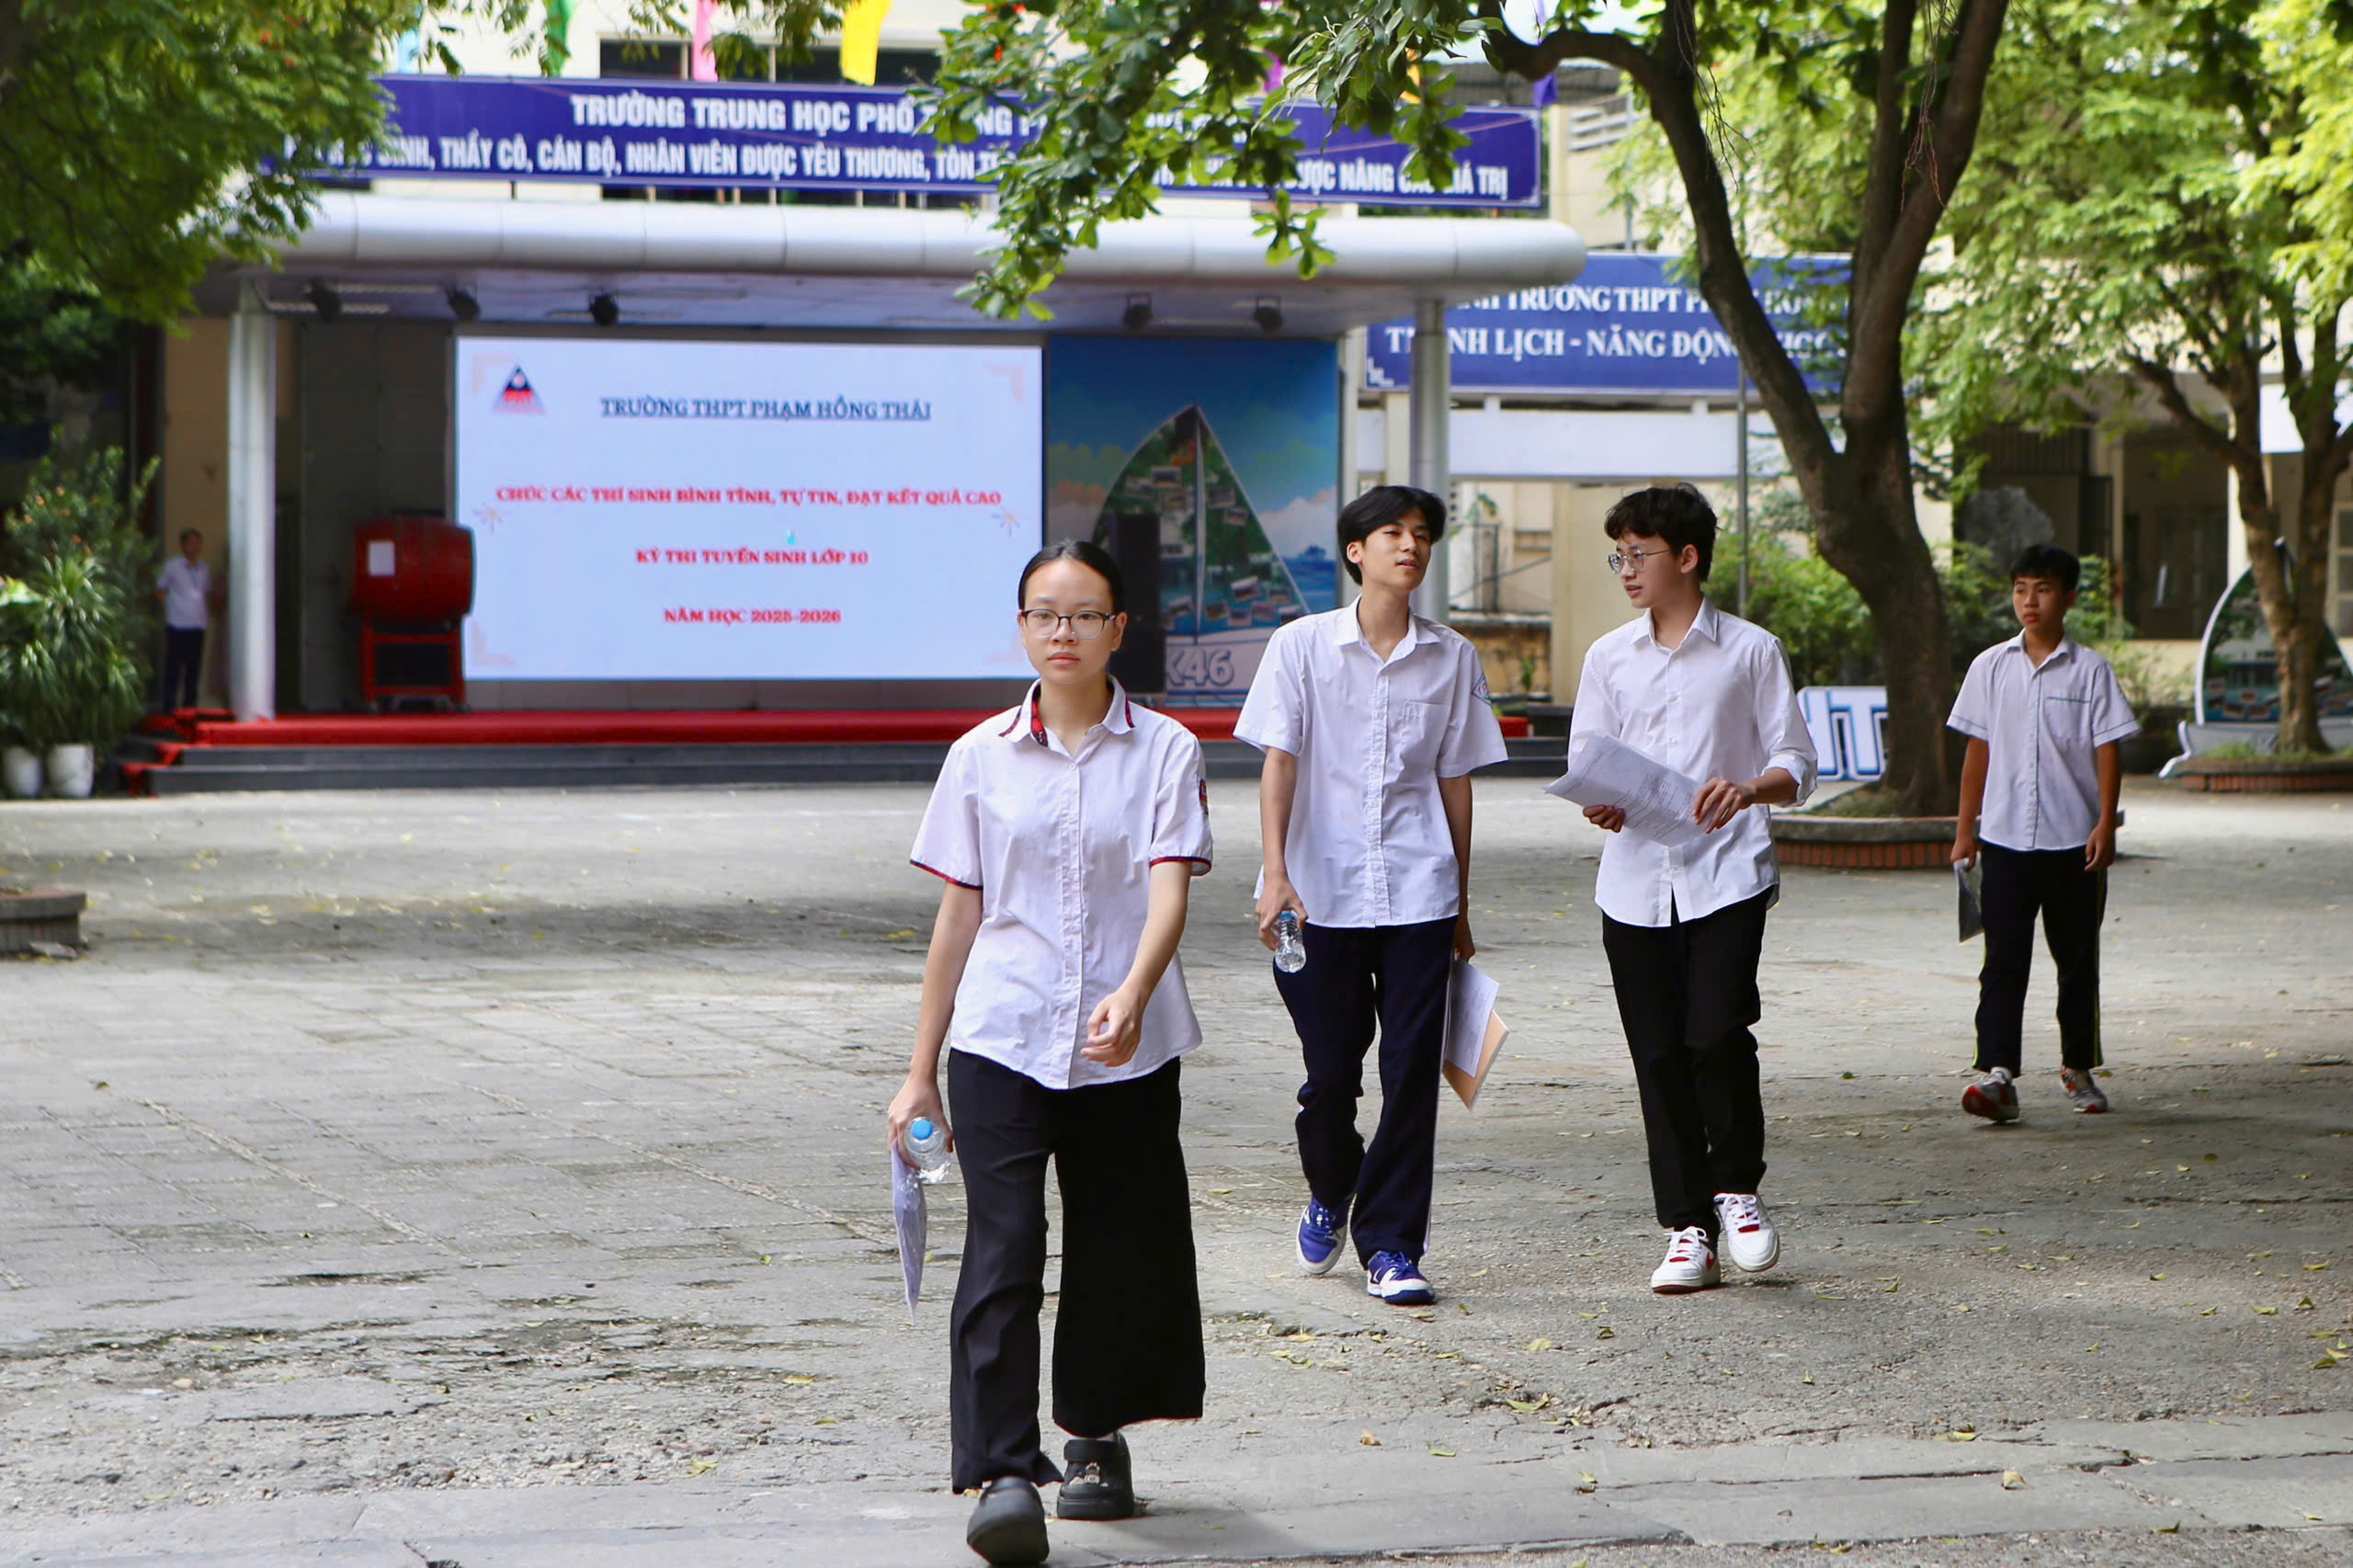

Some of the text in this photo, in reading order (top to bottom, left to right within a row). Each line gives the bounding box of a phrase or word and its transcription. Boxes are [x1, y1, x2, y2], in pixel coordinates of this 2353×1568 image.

[571, 89, 686, 128] TRƯỜNG
[692, 97, 787, 131] TRUNG
[792, 100, 850, 137] HỌC
[498, 132, 533, 173] CÔ,
[538, 133, 582, 171] CÁN
[586, 136, 622, 178] BỘ,
[626, 137, 686, 173] NHÂN
[689, 139, 736, 175] VIÊN
[741, 142, 797, 181] ĐƯỢC
[801, 142, 840, 176] YÊU
[935, 144, 975, 180] TÔN
[1339, 157, 1394, 193] NÂNG
[1476, 165, 1508, 200] TRỊ
[1614, 286, 1682, 312] THPT
[1495, 327, 1564, 361] LỊCH
[1586, 324, 1665, 357] NĂNG
[1671, 327, 1740, 364] ĐỘN
[600, 395, 688, 416] TRƯỜNG
[692, 399, 746, 418] THPT
[751, 400, 811, 421] PHẠM
[882, 401, 931, 420] THÁI
[629, 489, 671, 502] SINH
[966, 492, 1002, 505] CAO
[765, 551, 806, 563] SINH
[850, 551, 869, 564] 10
